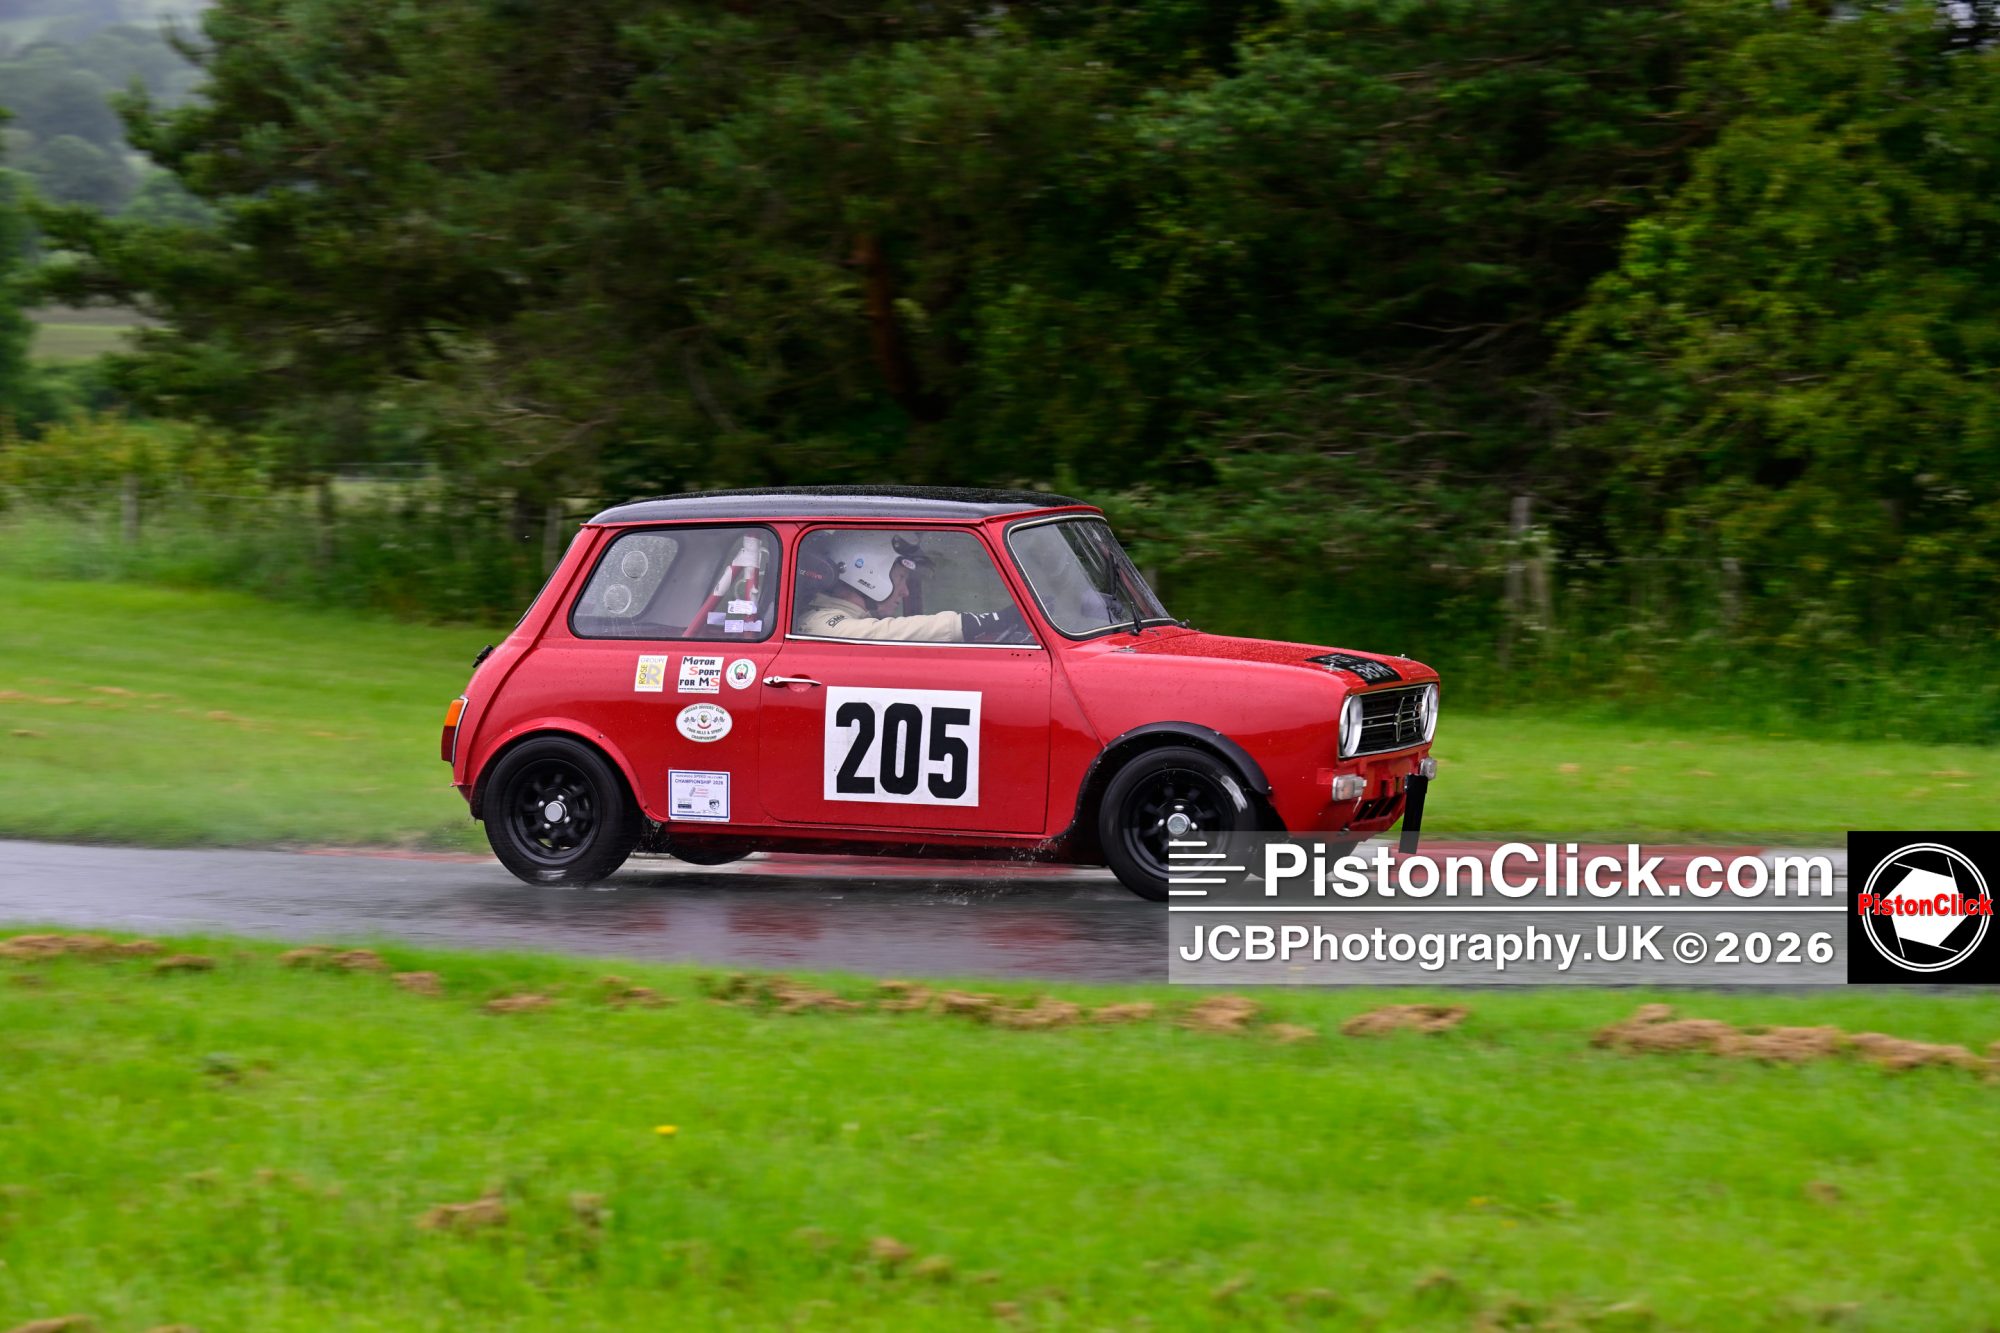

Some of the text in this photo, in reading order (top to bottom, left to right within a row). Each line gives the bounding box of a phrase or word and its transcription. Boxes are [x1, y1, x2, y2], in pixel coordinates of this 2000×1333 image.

[638, 664, 648, 684] ROSE
[699, 677, 720, 687] MS
[836, 702, 970, 799] 205
